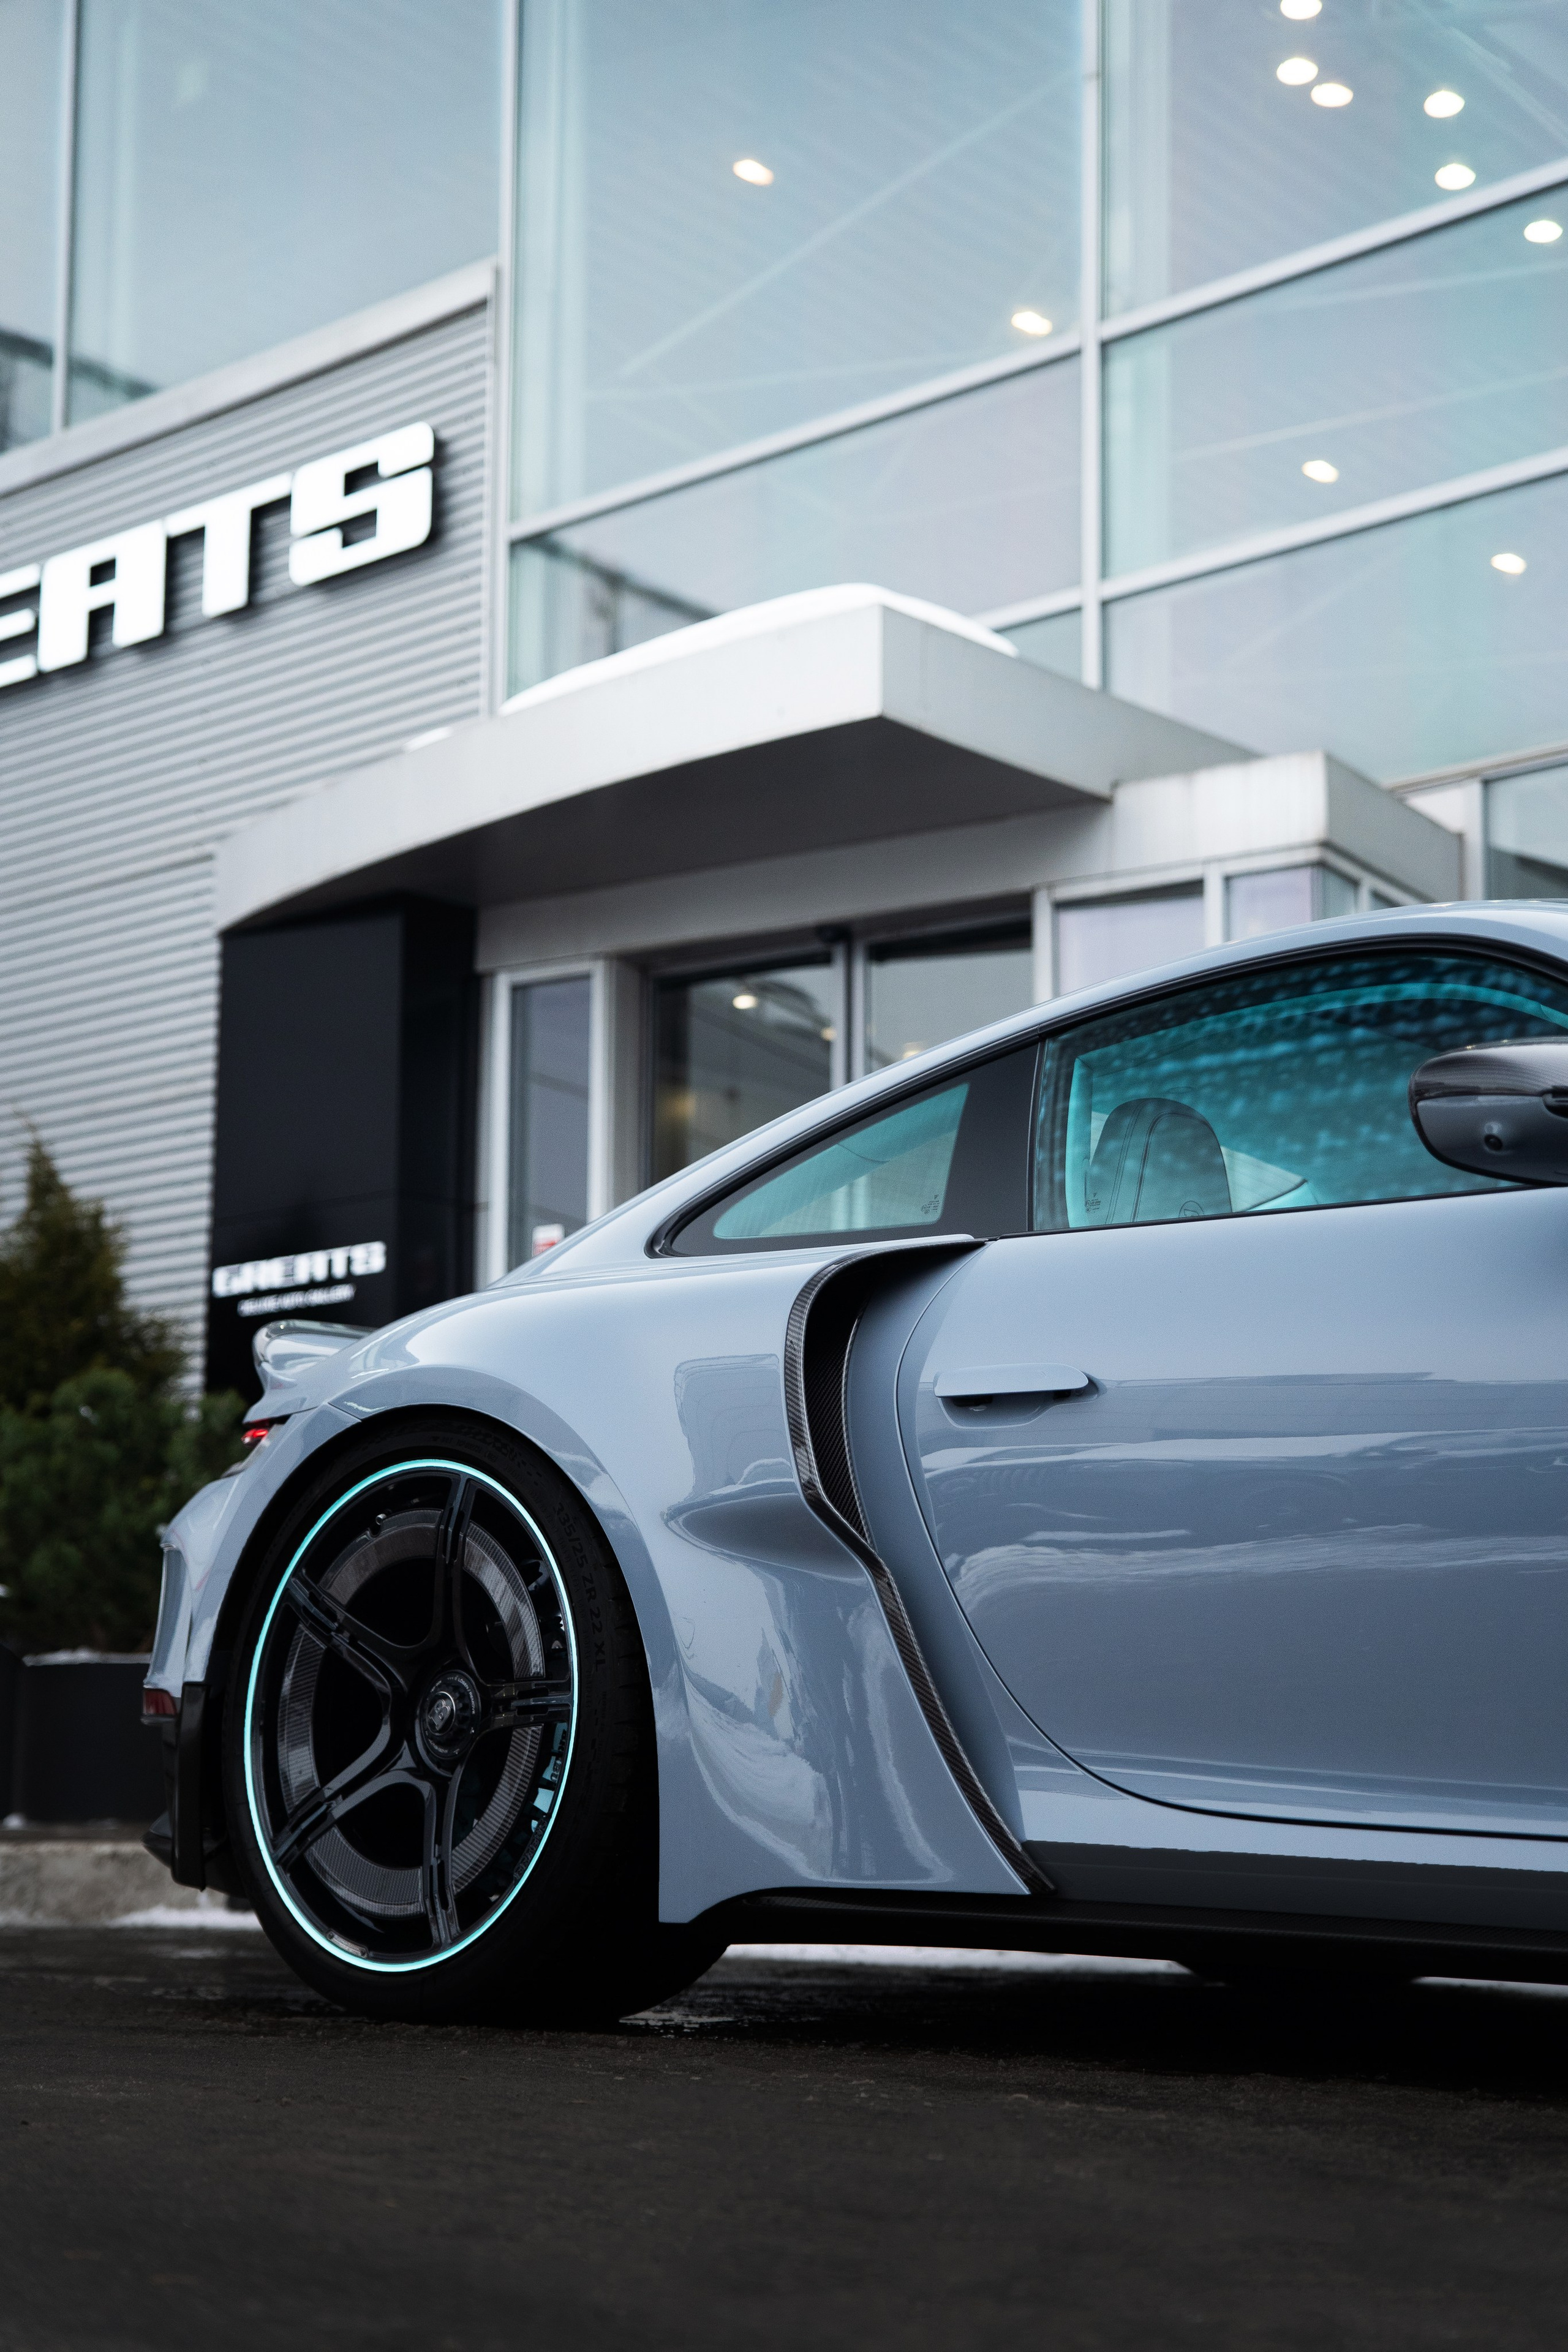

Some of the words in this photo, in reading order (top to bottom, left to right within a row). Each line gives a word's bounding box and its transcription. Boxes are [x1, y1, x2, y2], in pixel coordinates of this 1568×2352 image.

[554, 1502, 589, 1568] 335/25
[582, 1573, 597, 1602] ZR
[589, 1607, 603, 1634] 22
[594, 1642, 606, 1672] XL
